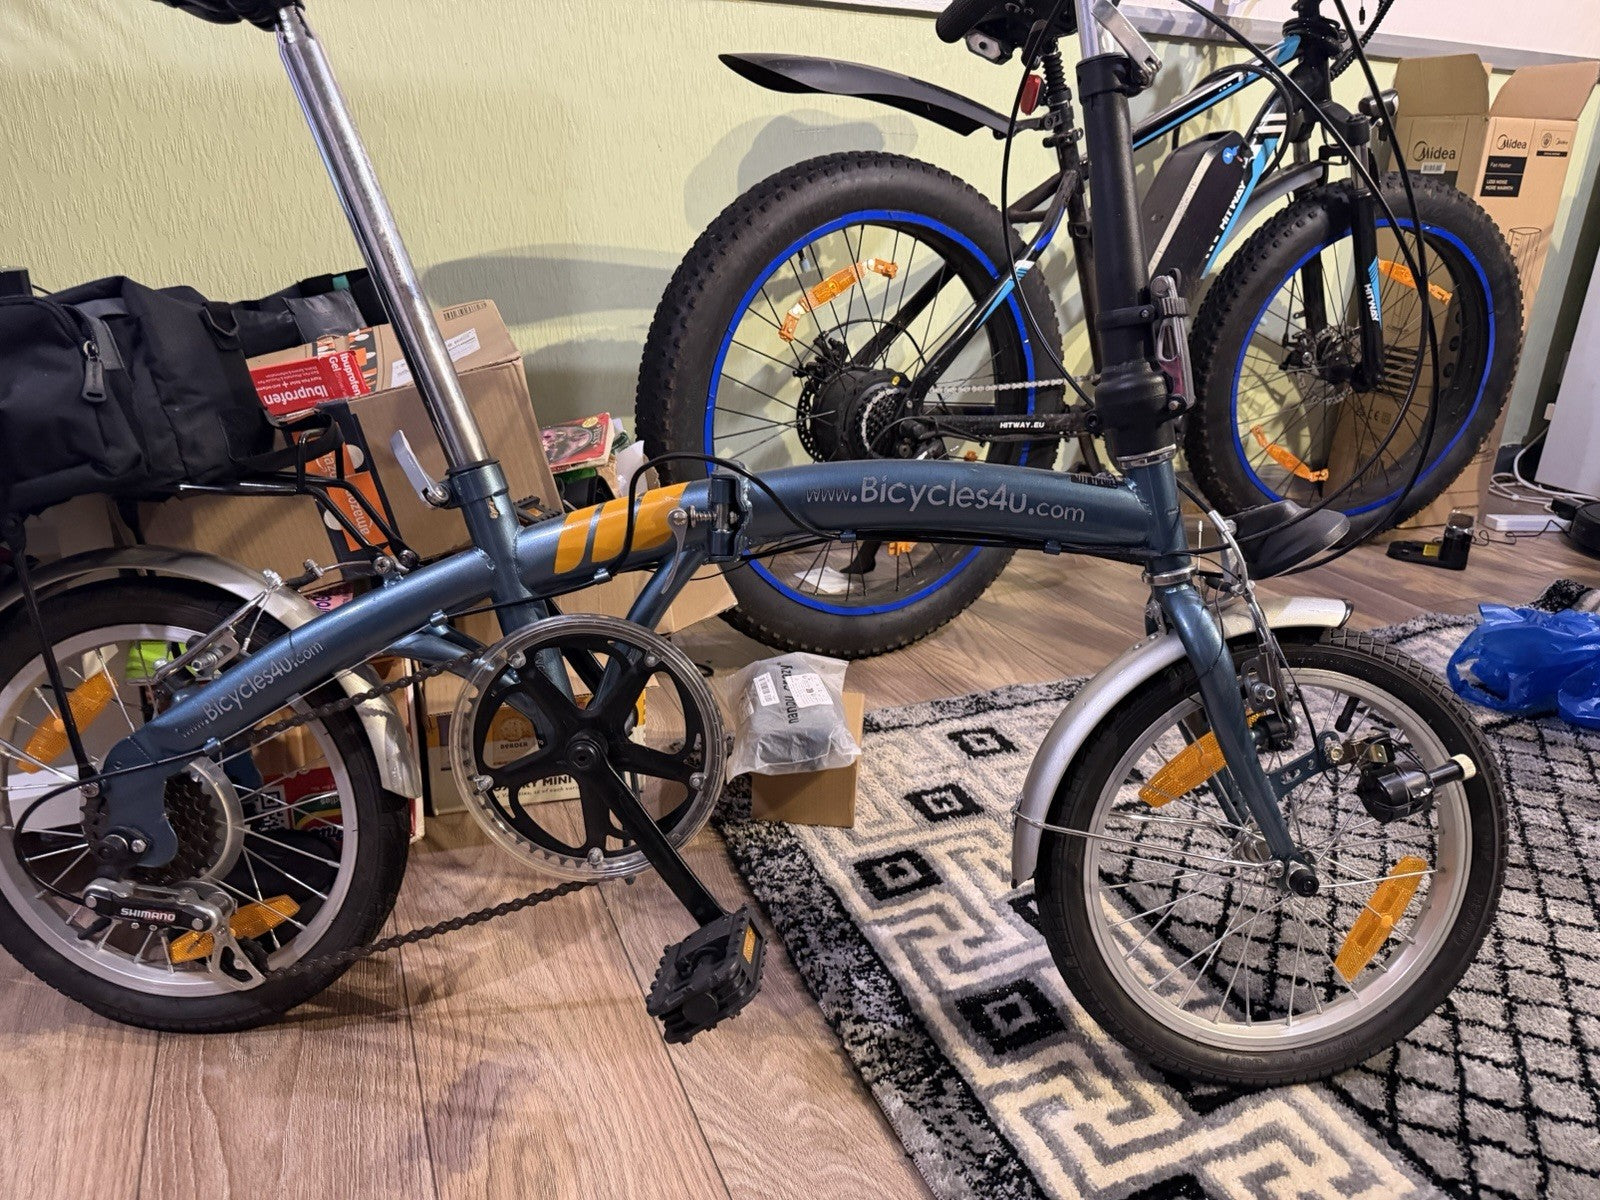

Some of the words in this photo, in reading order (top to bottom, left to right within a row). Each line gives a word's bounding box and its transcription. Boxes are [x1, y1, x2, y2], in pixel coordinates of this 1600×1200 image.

[1413, 140, 1456, 161] Midea
[1497, 134, 1527, 150] Midea
[1219, 180, 1246, 231] HITWAY
[1364, 283, 1379, 321] HITWAY
[329, 356, 342, 372] Gel
[341, 352, 361, 396] Ibuprofen
[264, 385, 329, 405] Ibuprofen
[1000, 421, 1045, 429] HITWAY.EU
[345, 490, 371, 535] amazo
[121, 908, 176, 922] SHIMANO
